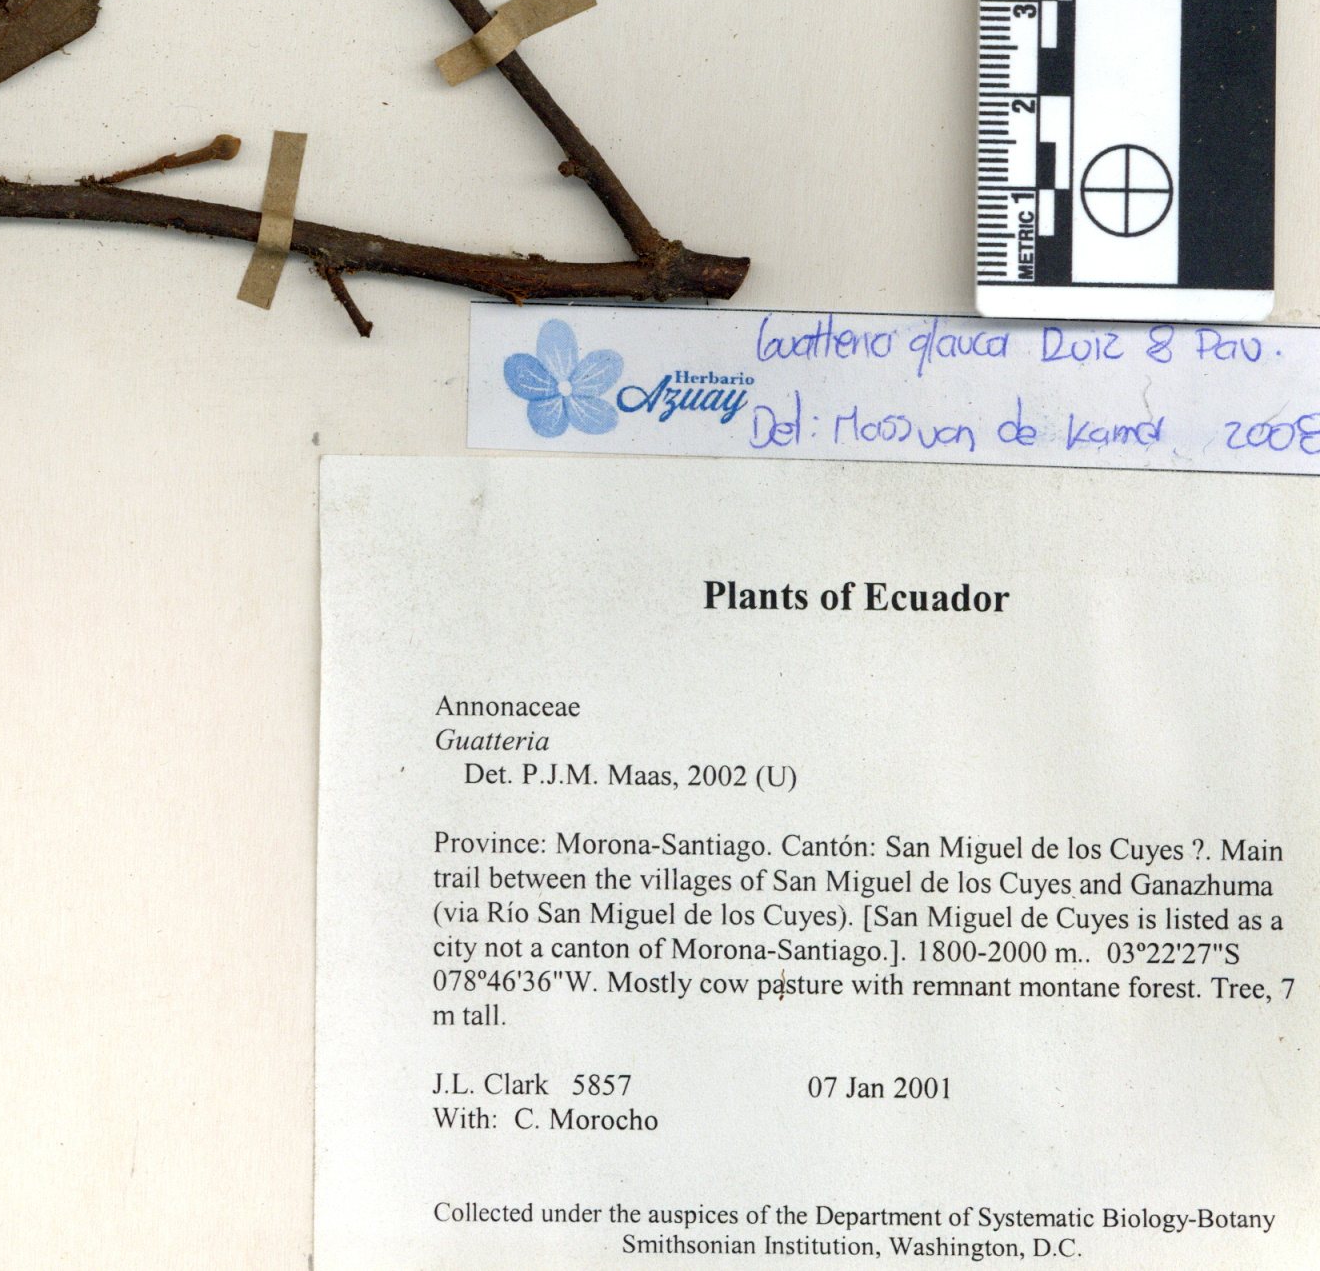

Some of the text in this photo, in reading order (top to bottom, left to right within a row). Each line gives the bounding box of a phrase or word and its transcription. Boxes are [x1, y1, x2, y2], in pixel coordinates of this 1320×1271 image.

[1013, 5, 1036, 18] 3
[1012, 100, 1035, 113] 2
[1012, 193, 1034, 279] METRIC 1
[674, 370, 755, 386] Herbario
[616, 374, 750, 424] Azuay
[996, 395, 1038, 447] de
[703, 580, 1011, 613] Plants of Ecuador
[435, 695, 581, 718] Annonaceae
[435, 728, 549, 751] Guatteria
[464, 762, 797, 793] Det. P.J.M. Maas, 2002 (U)
[434, 831, 546, 854] Province:
[557, 832, 772, 863] Morona-Santiago.
[781, 834, 875, 857] Cantón:
[886, 835, 930, 858] San
[940, 835, 1022, 865] Miguel
[1031, 836, 1059, 860] de
[1067, 836, 1102, 860] los
[1109, 837, 1184, 867] Cuyes
[1221, 838, 1283, 862] Main
[433, 865, 1274, 901] trail between the villages of San Miguel de los Cuyes and Ganazhuma
[433, 900, 1284, 935] (via Río San Miguel de los Cuyes). [San Miguel de Cuyes is listed as a
[433, 935, 478, 964] city
[485, 939, 523, 958] not
[530, 942, 544, 958] a
[551, 939, 629, 959] canton
[638, 937, 667, 960] of
[671, 937, 907, 968] Morona-Santiago.].
[919, 940, 1047, 963] 1800-2000
[608, 970, 693, 1000] Mostly
[699, 978, 749, 994] cow
[757, 975, 844, 1002] pasture
[851, 972, 904, 996] with
[912, 977, 1011, 997] remnant
[1019, 978, 1120, 998] montane
[1128, 975, 1201, 999] forest.
[1210, 976, 1272, 1004] Tree,
[1281, 977, 1295, 1000] 7
[433, 1003, 506, 1026] m tall.
[432, 1072, 632, 1096] J.L. Clark 5857
[808, 1076, 949, 1099] 07 Jan 2001
[433, 1106, 659, 1131] With: C. Morocho
[433, 1202, 1276, 1234] Collected under the auspices of the Department of Systematic Biology-Botany
[622, 1234, 1082, 1262] Smithsonian Institution, Washington, D.C.
